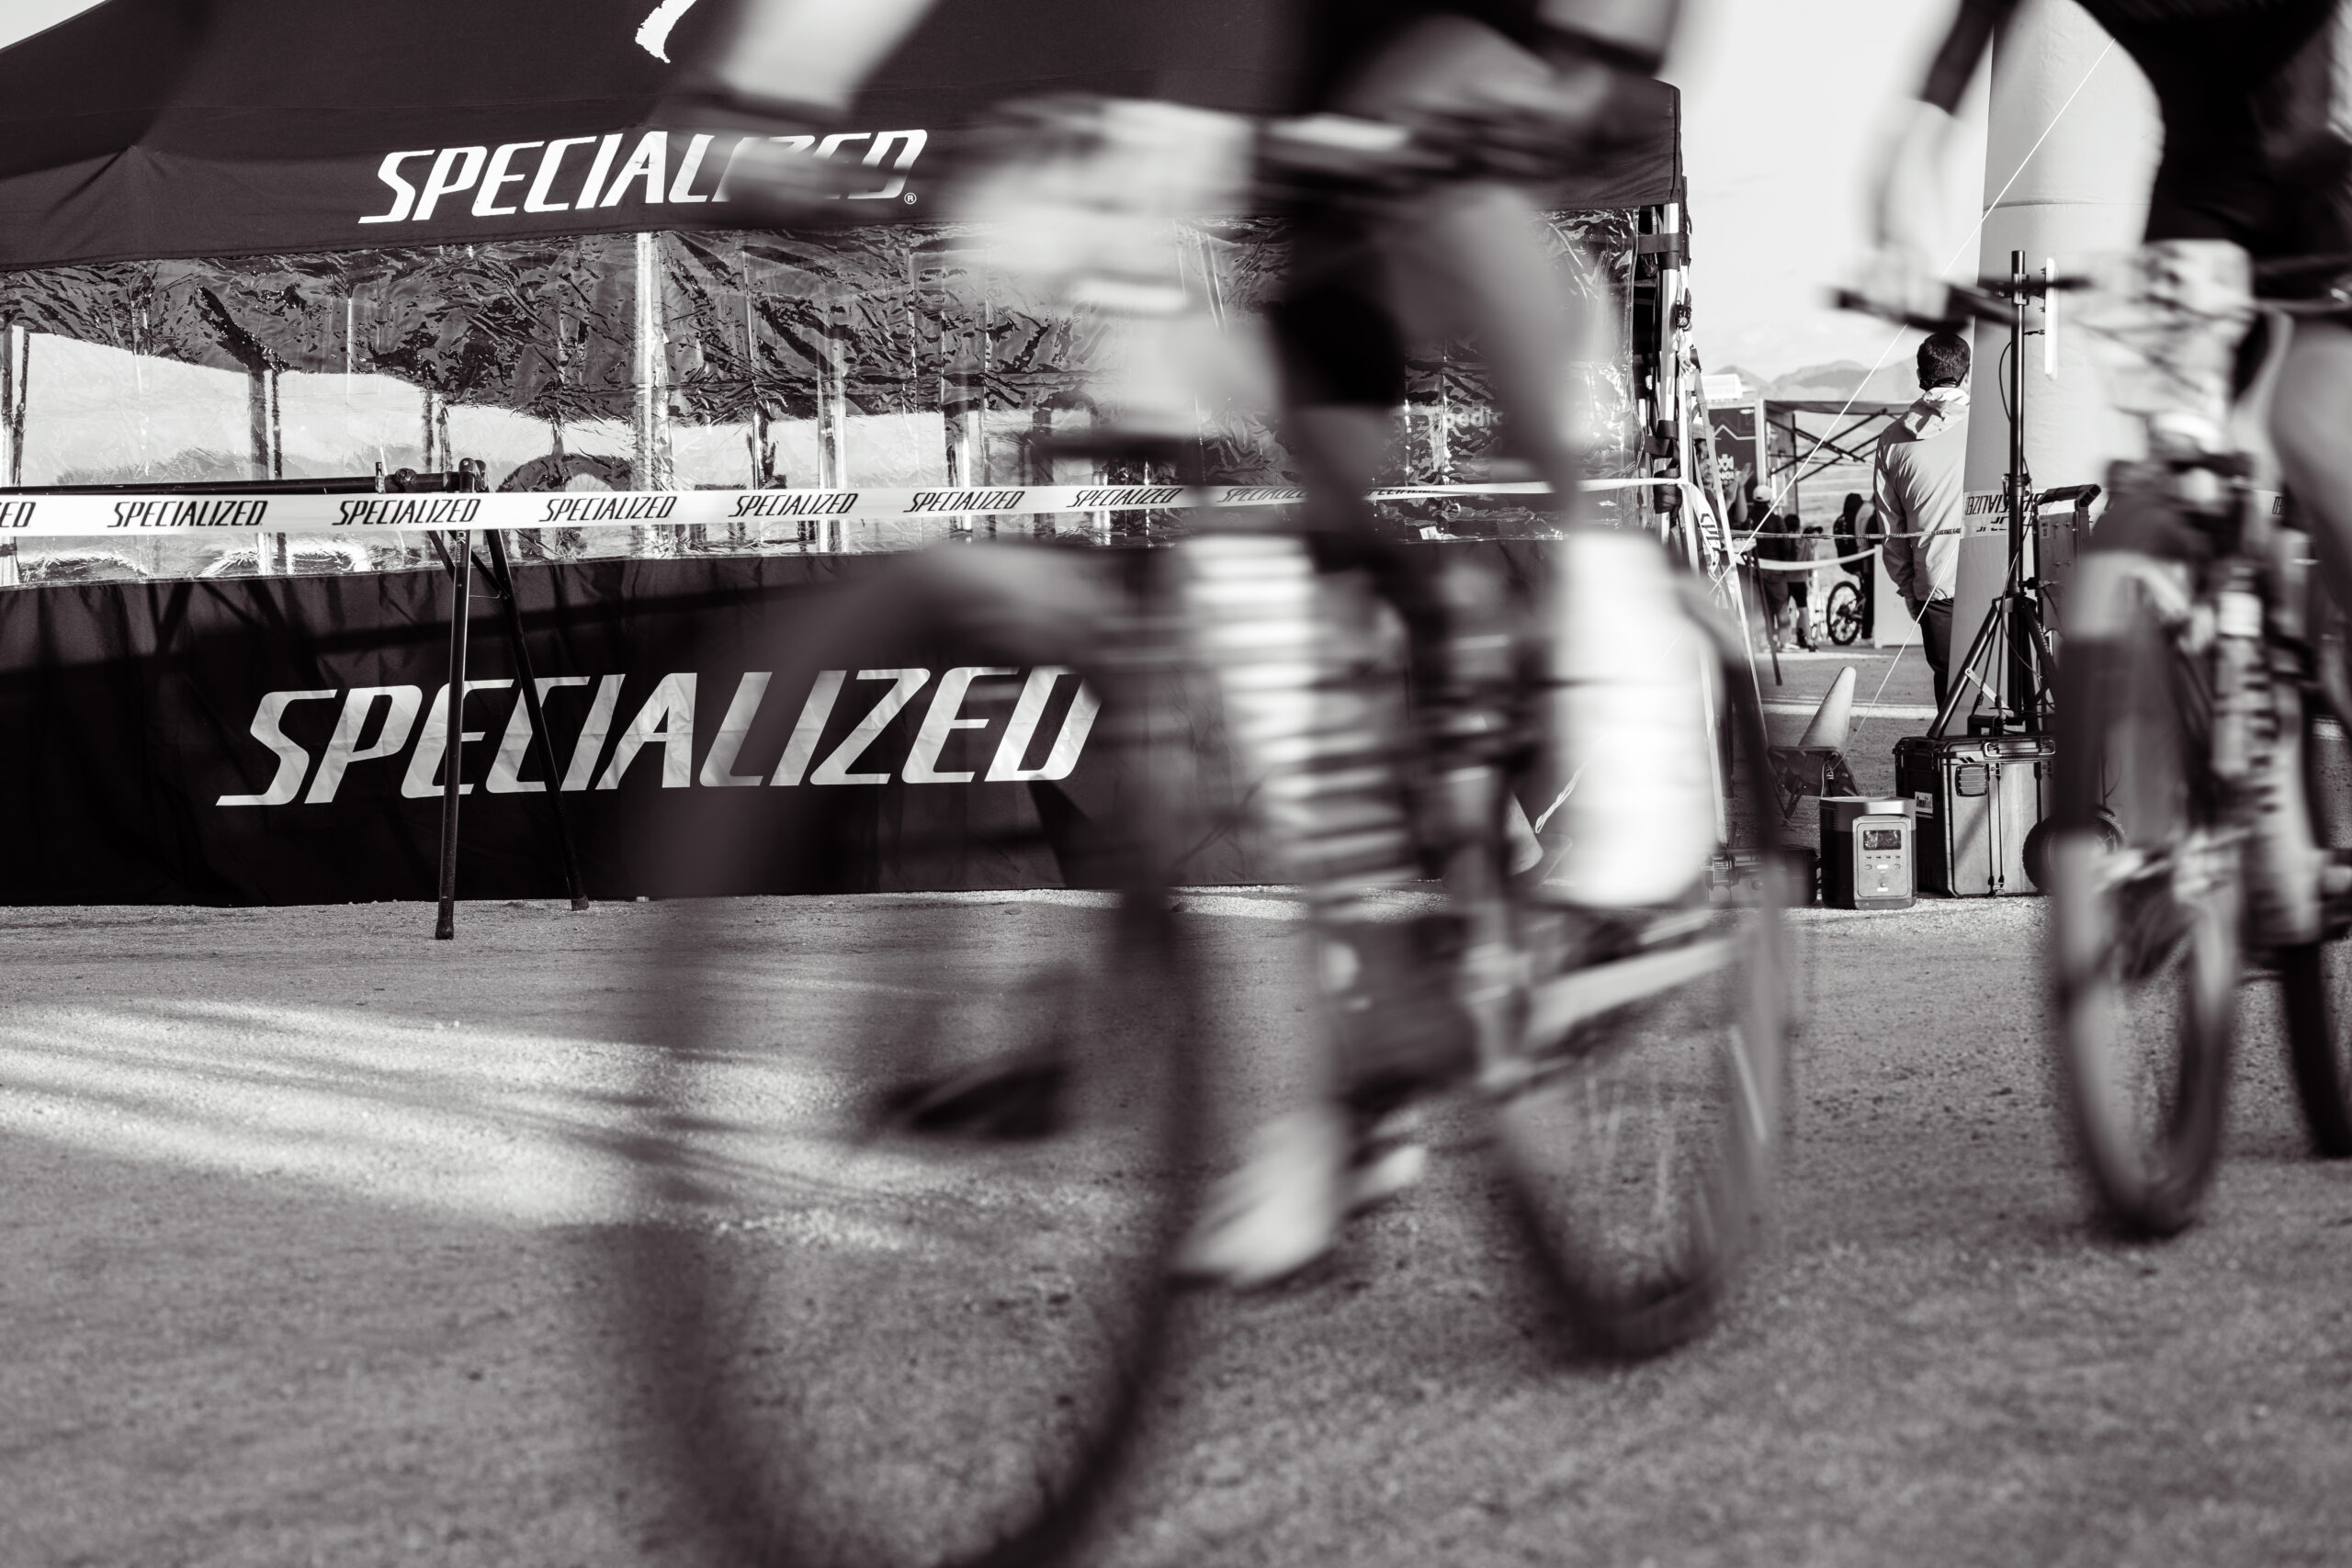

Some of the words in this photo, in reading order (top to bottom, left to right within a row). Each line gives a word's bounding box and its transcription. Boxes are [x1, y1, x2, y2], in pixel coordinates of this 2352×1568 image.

[107, 501, 267, 527] SPECIALIZED
[332, 499, 481, 525] SPECIALIZED
[538, 496, 677, 522] SPECIALIZED
[728, 492, 858, 517] SPECIALIZED
[903, 491, 1024, 513] SPECIALIZED
[1067, 487, 1183, 507] SPECIALIZED
[216, 667, 1102, 807] SPECIALIZED
